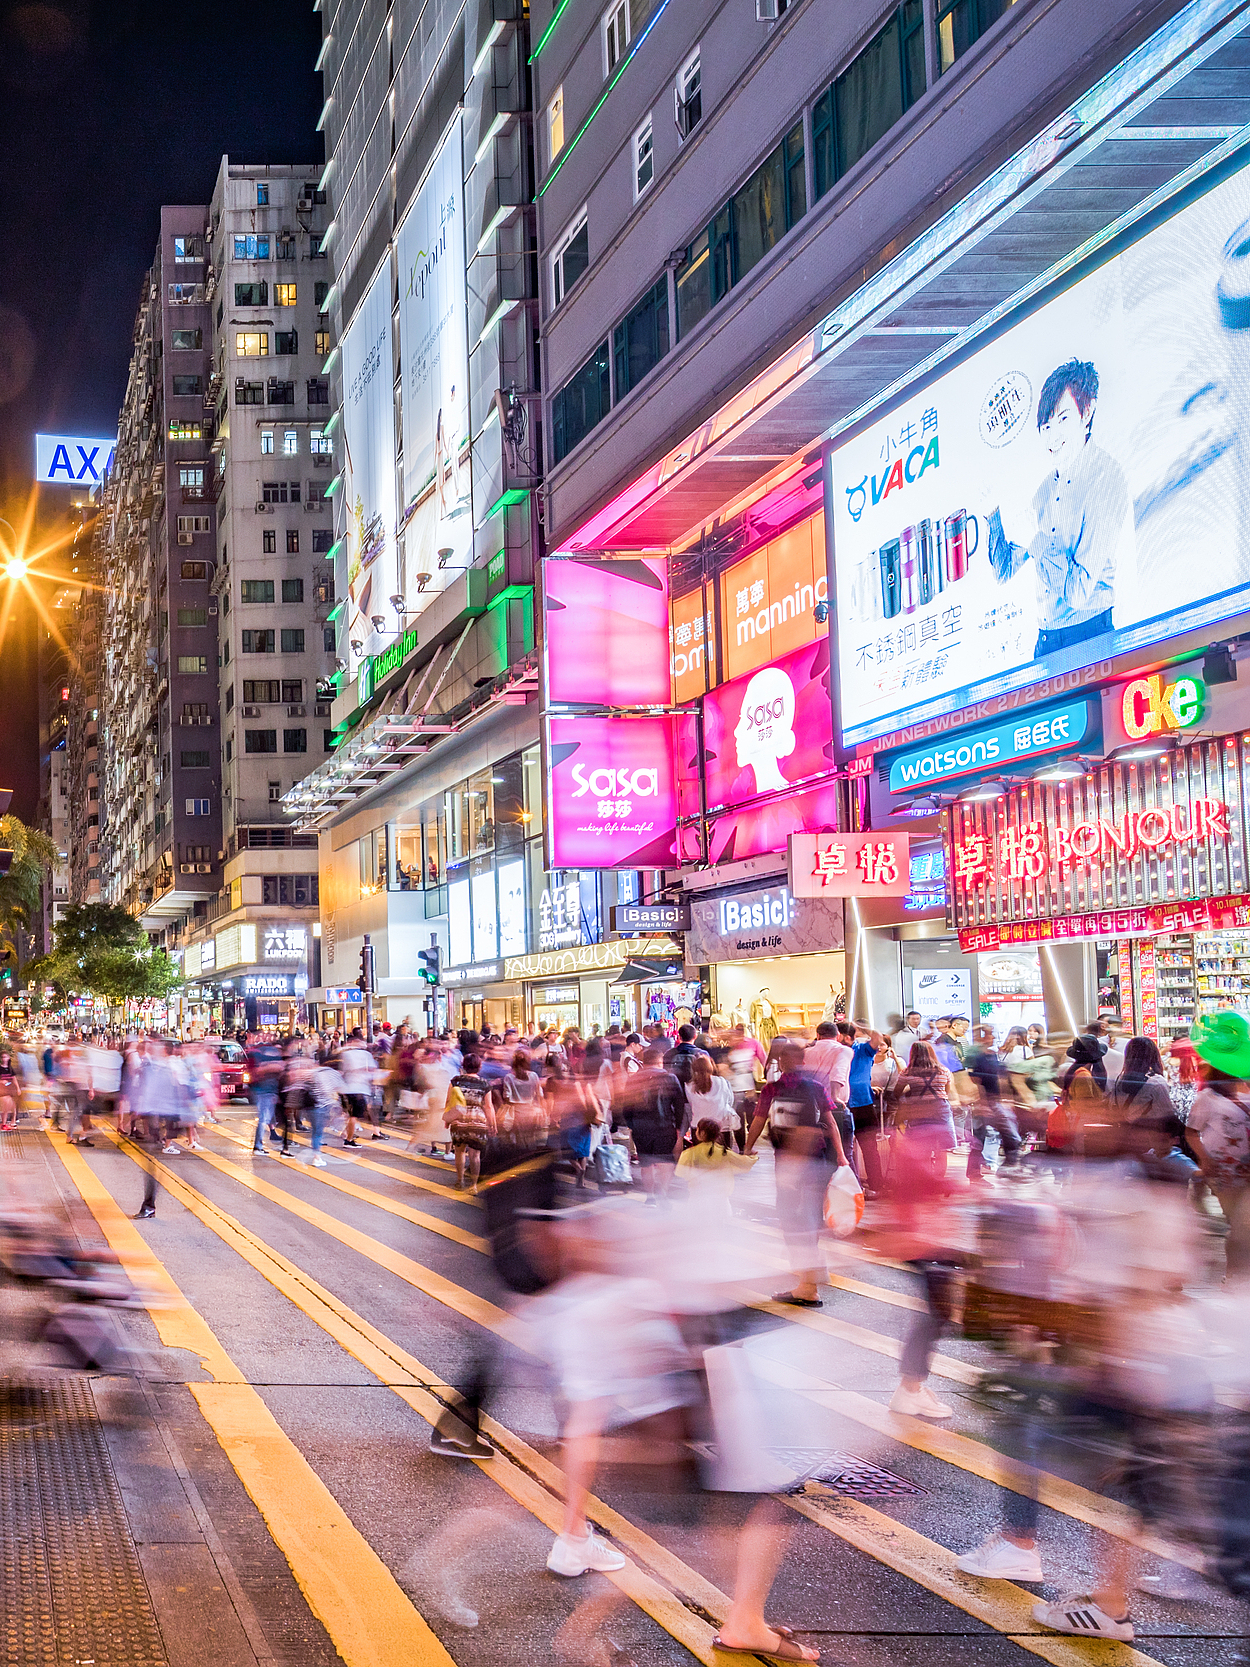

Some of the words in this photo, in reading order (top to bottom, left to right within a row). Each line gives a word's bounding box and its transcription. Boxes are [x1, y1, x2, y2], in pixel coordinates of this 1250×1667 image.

[880, 406, 939, 463] 小牛角
[870, 434, 940, 506] VACA
[736, 578, 765, 617] 萬寧
[374, 642, 404, 684] Holiday
[403, 630, 418, 656] Inn
[873, 733, 898, 753] JM
[900, 704, 991, 746] NETWORK
[997, 661, 1114, 716] 27230020
[900, 737, 1001, 782] watsons
[1013, 714, 1070, 751] 屈臣氏
[850, 755, 872, 774] JM
[597, 799, 633, 819] 莎莎
[576, 823, 603, 836] making
[604, 822, 619, 836] life
[620, 822, 654, 836] beautiful
[1055, 797, 1231, 864] BONJOUR
[538, 881, 581, 933] 金至尊
[623, 908, 684, 923] [Basic]:
[720, 888, 795, 936] [Basic]:
[1235, 904, 1250, 926] 激
[1163, 907, 1203, 931] SALE
[265, 929, 306, 950] 六福
[736, 938, 760, 950] design
[761, 937, 767, 947] &
[768, 935, 782, 948] life
[968, 931, 998, 950] SALE
[246, 978, 288, 988] RADO
[921, 974, 938, 982] NIKE
[918, 995, 938, 1005] intime
